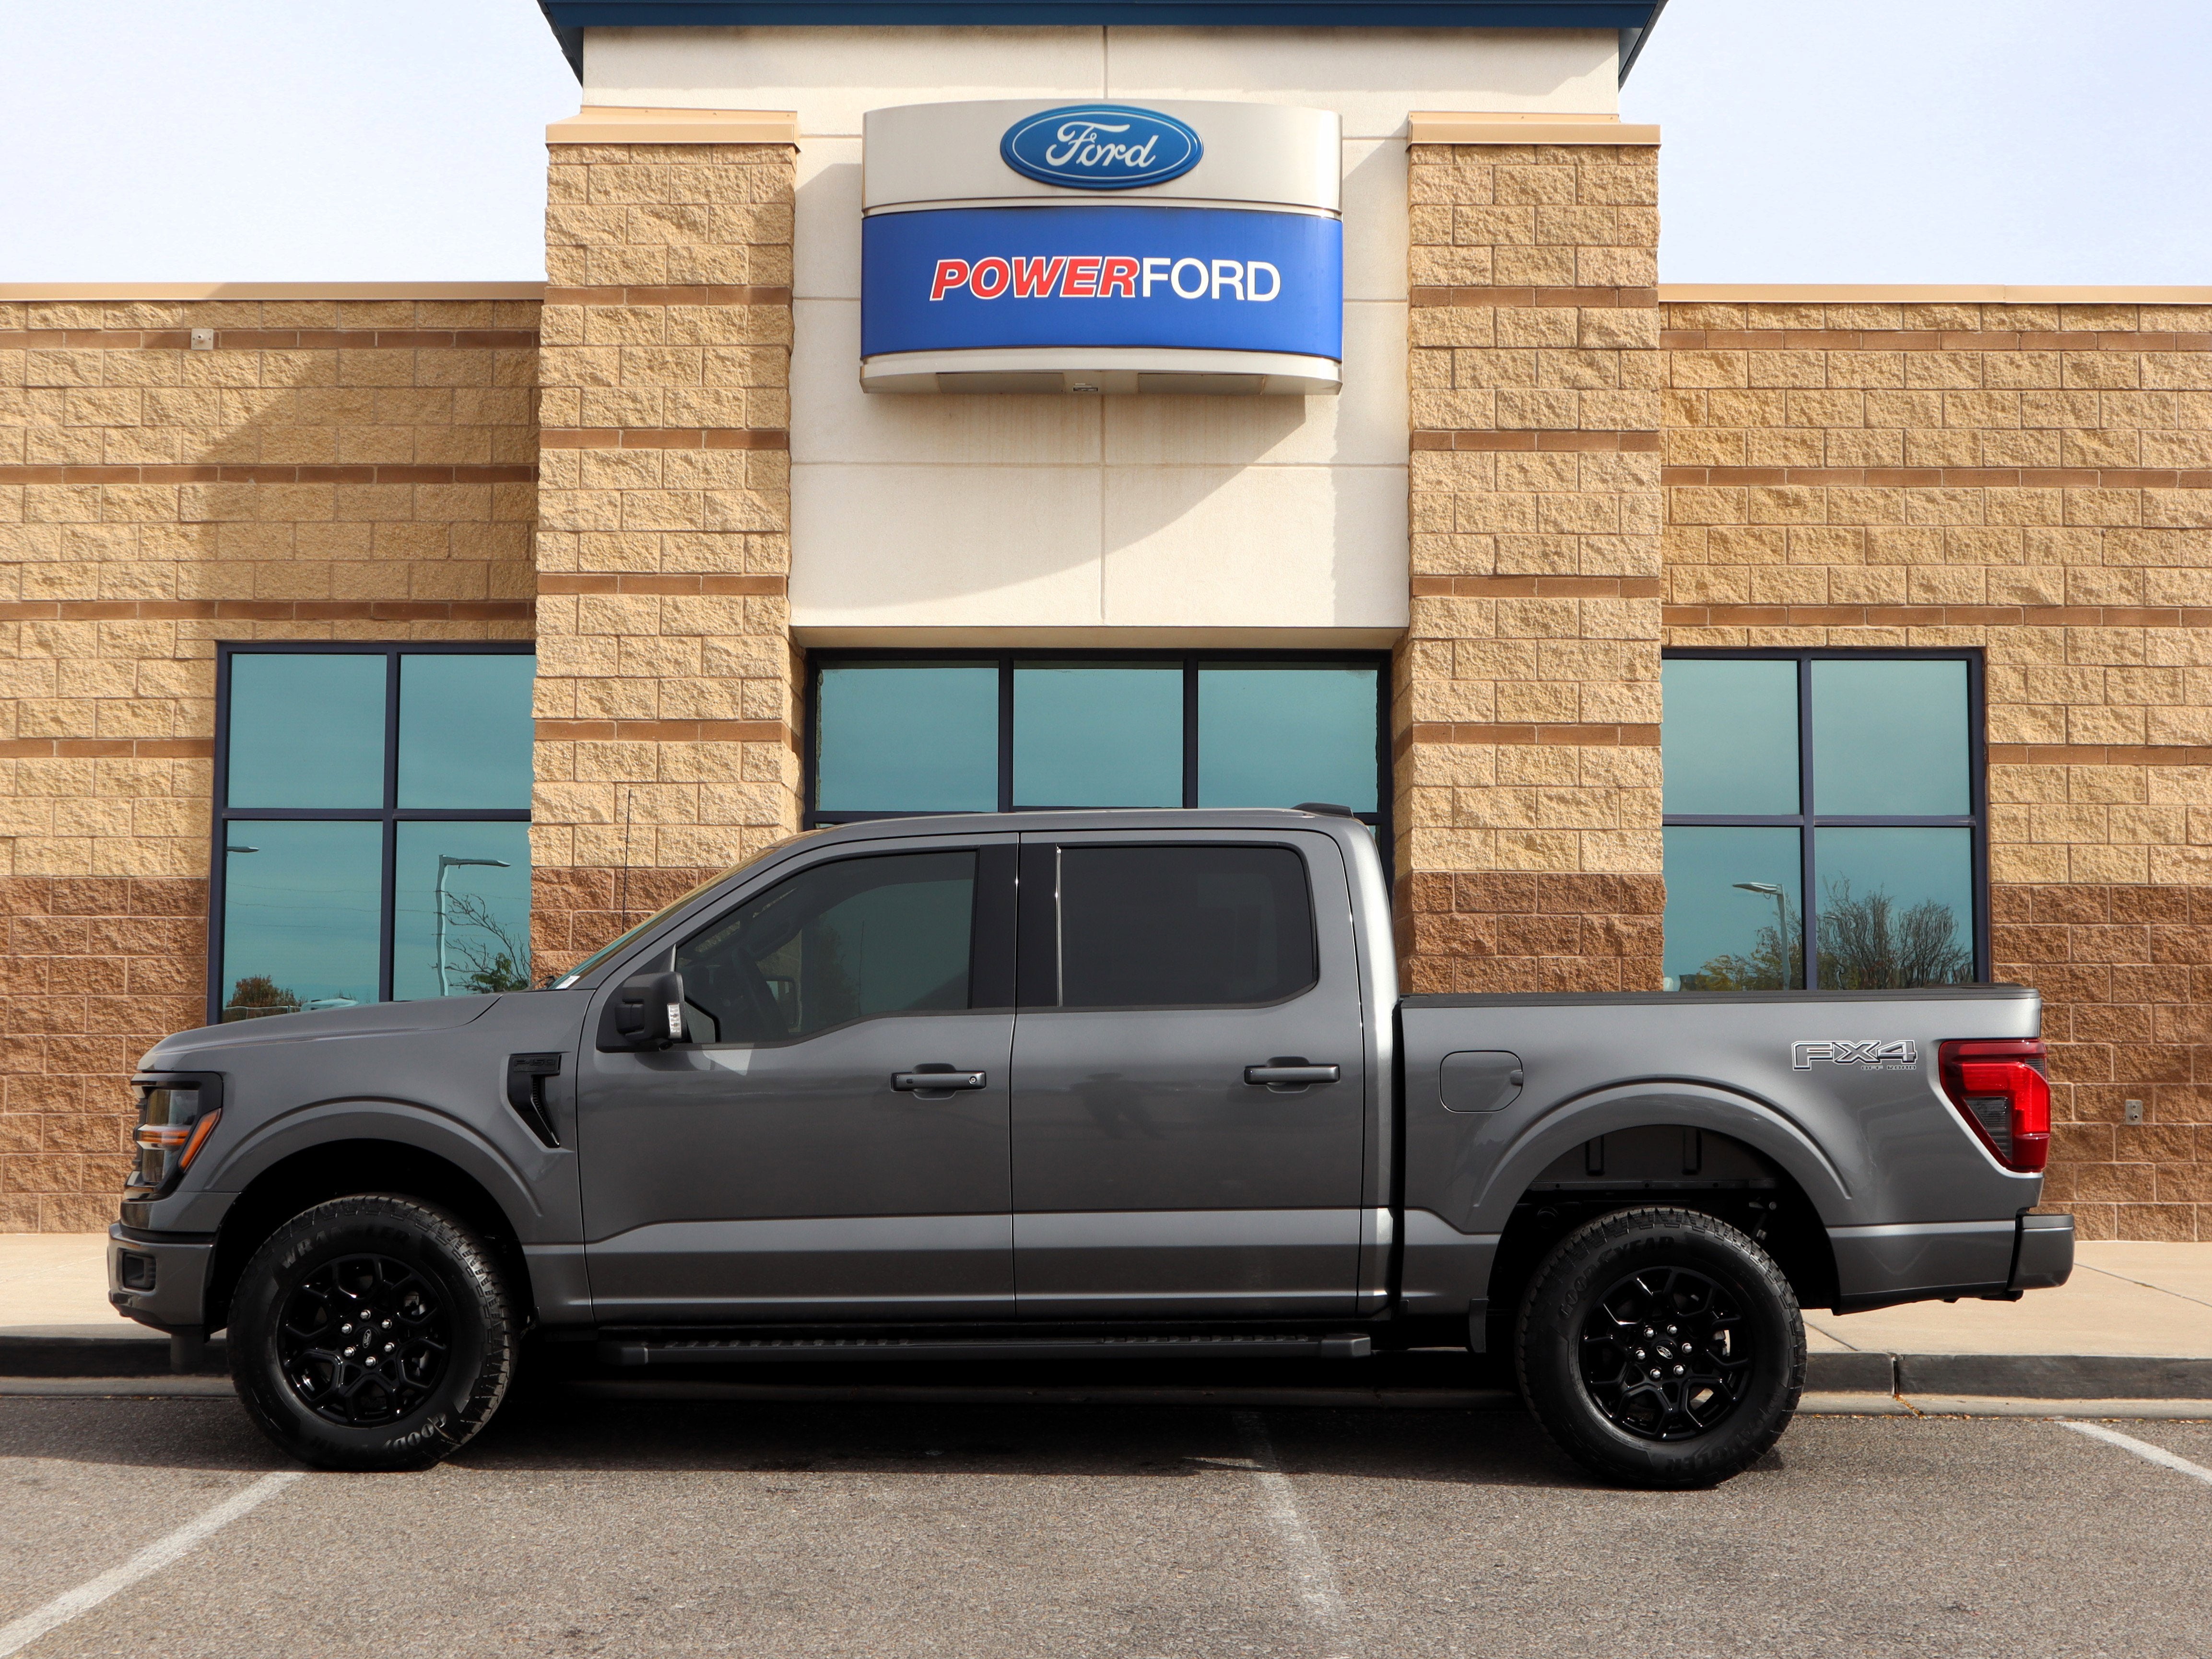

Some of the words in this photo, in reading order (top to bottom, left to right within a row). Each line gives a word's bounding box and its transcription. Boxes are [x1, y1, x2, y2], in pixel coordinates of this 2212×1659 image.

[1045, 120, 1159, 169] Ford
[1791, 1039, 1918, 1071] FX4
[281, 1223, 410, 1269] WRANLER
